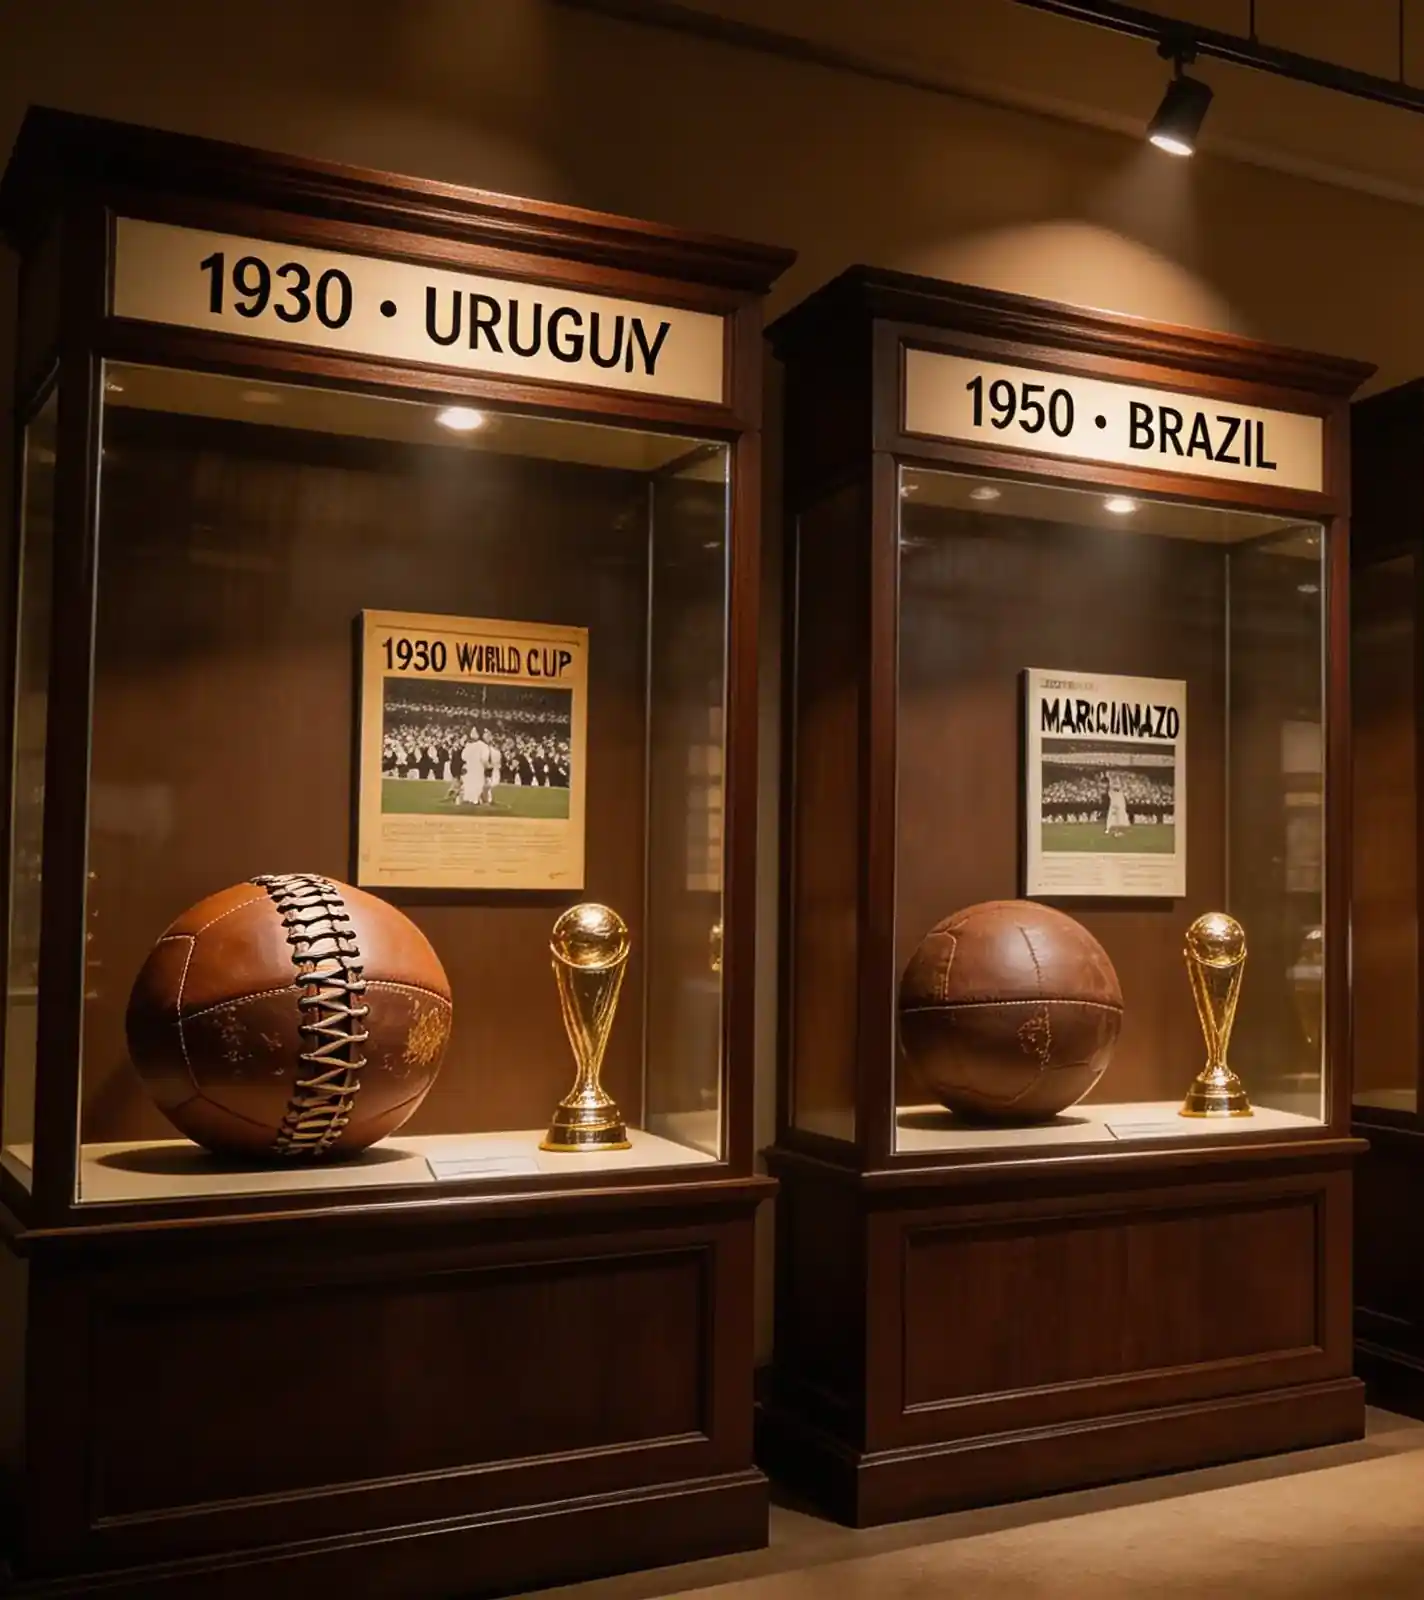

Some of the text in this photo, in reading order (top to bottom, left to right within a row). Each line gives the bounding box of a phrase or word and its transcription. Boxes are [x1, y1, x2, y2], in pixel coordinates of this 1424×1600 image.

[199, 251, 353, 330] 1930
[965, 375, 1277, 471] 1950 BRAZIL
[382, 636, 447, 673] 1930
[526, 647, 572, 678] CUP
